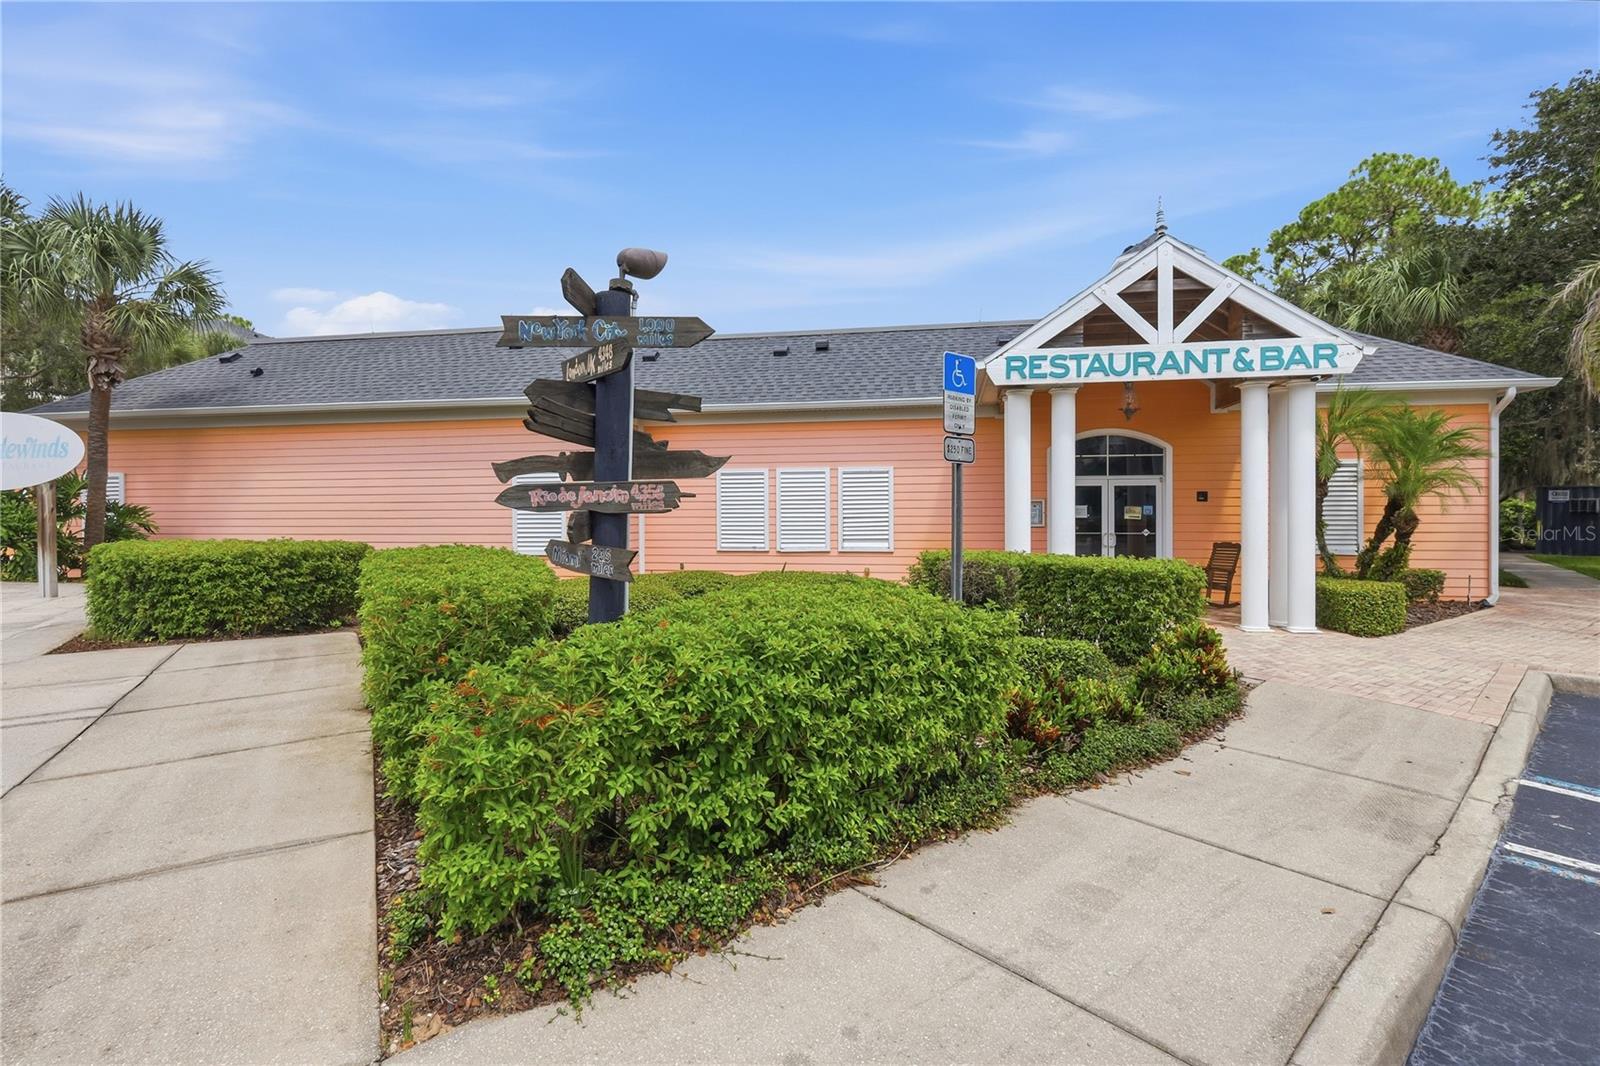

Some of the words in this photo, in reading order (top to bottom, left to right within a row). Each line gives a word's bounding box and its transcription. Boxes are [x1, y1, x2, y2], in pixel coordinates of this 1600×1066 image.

[518, 319, 554, 343] New
[552, 318, 588, 341] York
[1005, 347, 1230, 380] RESTAURANT
[1259, 343, 1339, 371] BAR
[949, 404, 969, 413] DISABLED
[552, 544, 582, 568] Miami
